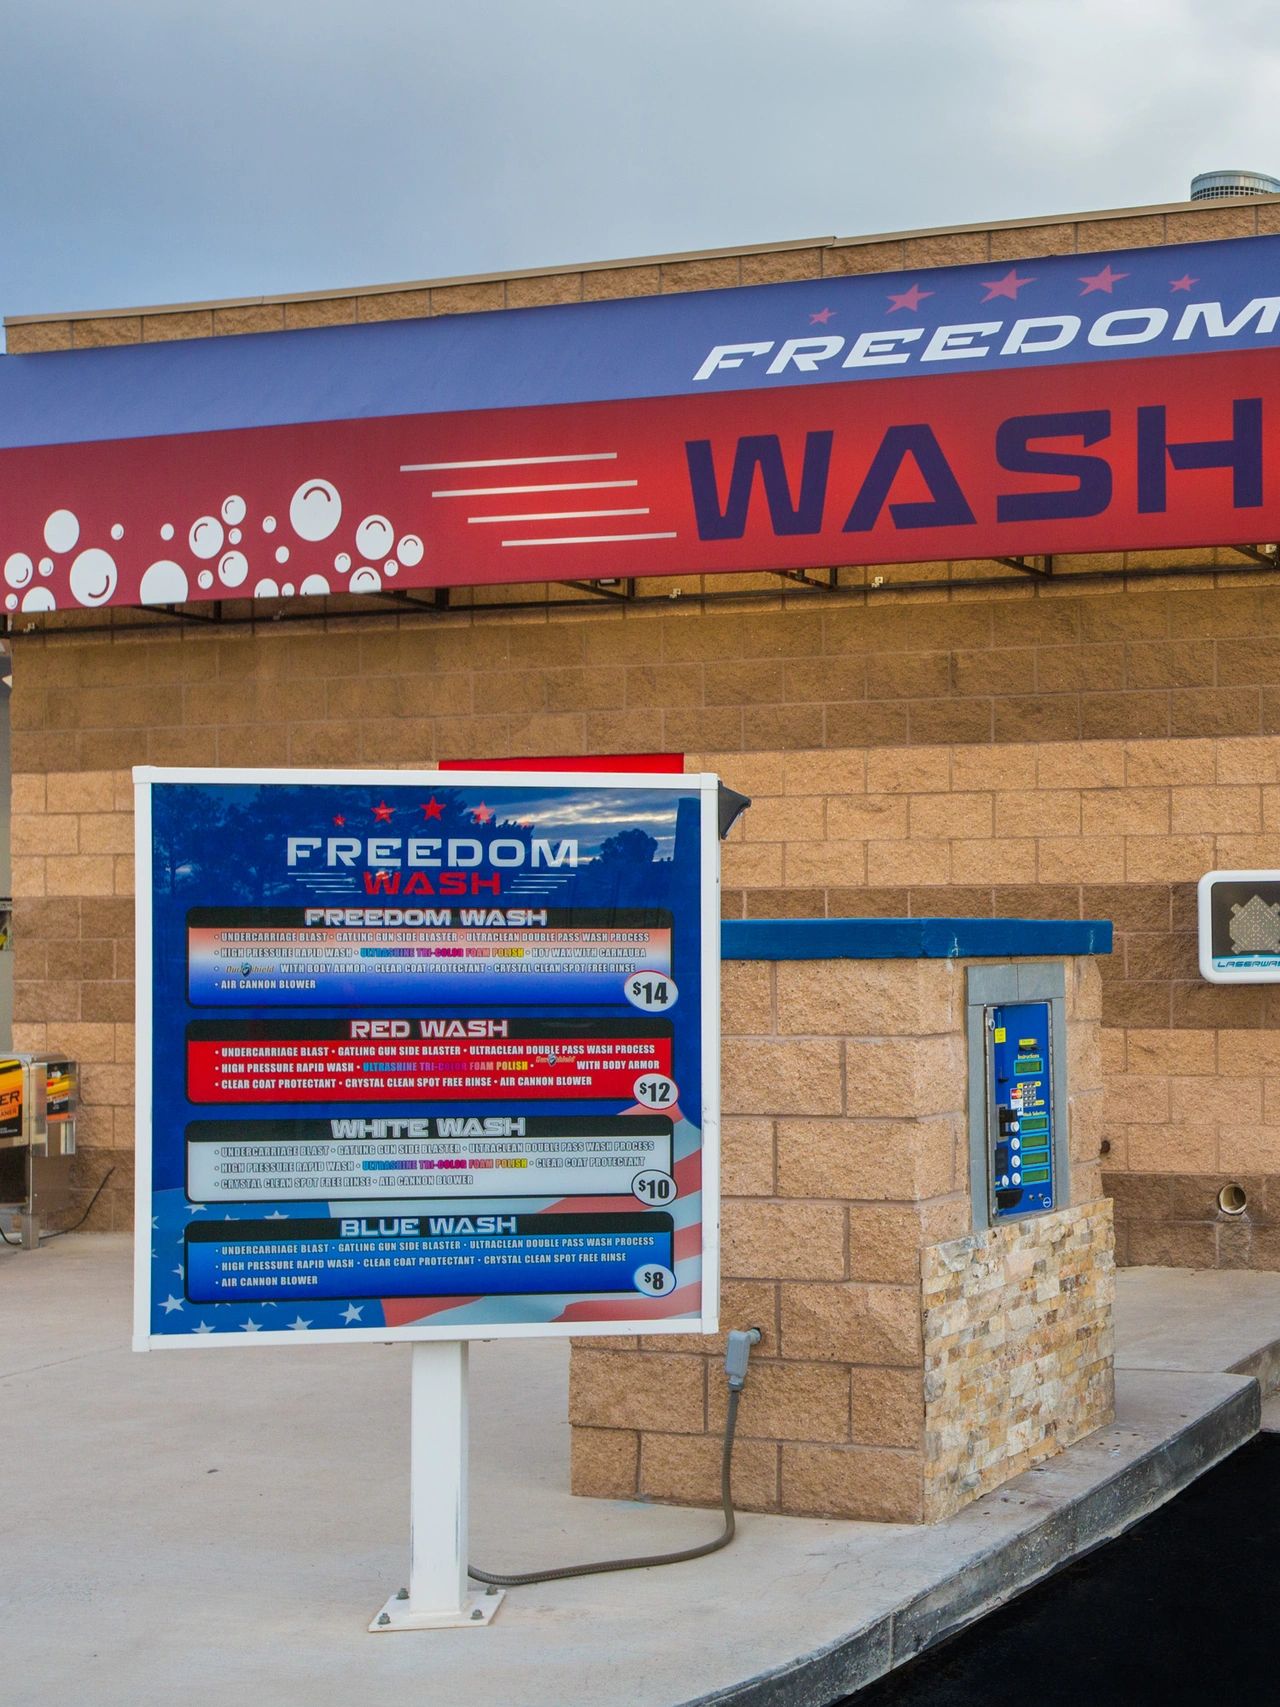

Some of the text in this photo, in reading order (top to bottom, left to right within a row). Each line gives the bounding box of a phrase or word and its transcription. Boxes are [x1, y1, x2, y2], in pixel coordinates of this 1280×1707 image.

[684, 397, 1264, 541] WASH
[286, 837, 579, 868] FREEDOM
[363, 871, 502, 896] WASH
[304, 908, 548, 927] FREEDOM WASH
[221, 932, 649, 942] UNDERCARRIAGE BLAST GATLING GUN SIDE BLASTER ULTRACLEAN DOUBLE PASS WASH PROCESS
[220, 948, 647, 958] HIGH PRESSURE RAPID WASH FOAM POLISH HOT WAX WITH CARNAUBA
[280, 963, 306, 973] WITH
[307, 963, 332, 973] BODY
[334, 963, 366, 973] ARMOR
[375, 963, 403, 973] CLEAR
[404, 963, 427, 973] COAT
[429, 963, 486, 973] PROTECTANT
[494, 963, 532, 973] CRYSTAL
[533, 963, 561, 973] CLEAN
[562, 963, 586, 973] SPOT
[587, 963, 608, 973] FREE
[610, 963, 636, 973] RINSE
[221, 980, 316, 989] AIR CANNON BLOWER
[632, 982, 669, 1005] $14
[350, 1020, 509, 1039] RED WASH
[221, 1044, 655, 1057] UNDERCARRIAGE BLAST GATLING GUN SIDE BLASTER ULTRACLEAN DOUBLE PASS WASH PROCESS
[221, 1063, 244, 1073] HIGH
[247, 1063, 294, 1073] PRESSURE
[296, 1062, 324, 1072] RAPID
[326, 1062, 354, 1072] WASH
[469, 1061, 494, 1071] FOAM
[496, 1061, 528, 1071] POLISH
[576, 1060, 601, 1070] WITH
[602, 1060, 626, 1070] BODY
[628, 1060, 660, 1070] ARMOR
[221, 1076, 592, 1089] CLEAR COAT PROTECTANT CRYSTAL CLEAN SPOT FREE RINSE AIR CANNON BLOWER
[639, 1081, 671, 1103] $12
[330, 1117, 527, 1139] WHITE WASH
[638, 1179, 670, 1199] $10
[340, 1216, 518, 1238] BLUE WASH
[221, 1236, 654, 1255] UNDERCARRIAGE BLAST GATLING GUN SIDE BLASTER ULTRACLEAN DOUBLE PASS WASH PROCESS
[221, 1252, 626, 1271] HIGH PRESSURE RAPID WASH CLEAR COAT PROTECTANT CRYSTAL CLEAN SPOT FREE RINSE
[221, 1276, 318, 1287] AIR CANNON BLOWER
[644, 1271, 664, 1290] $8
